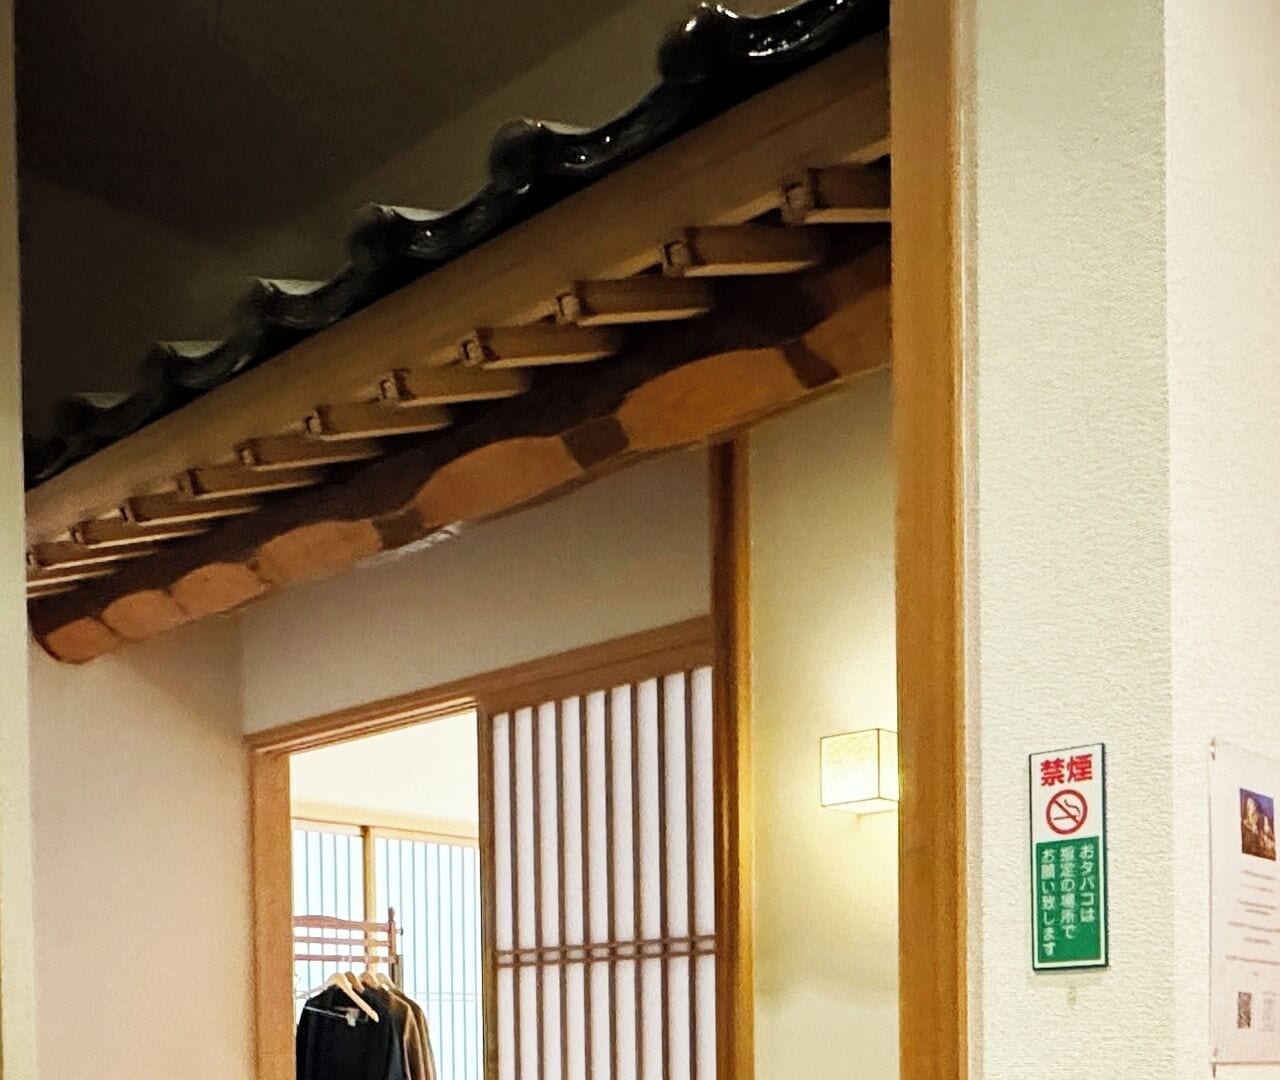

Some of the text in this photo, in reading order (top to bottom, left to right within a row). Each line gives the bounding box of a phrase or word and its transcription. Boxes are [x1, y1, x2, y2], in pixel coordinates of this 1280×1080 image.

[1041, 753, 1093, 786] 禁煙
[1079, 843, 1095, 923] おタバコは
